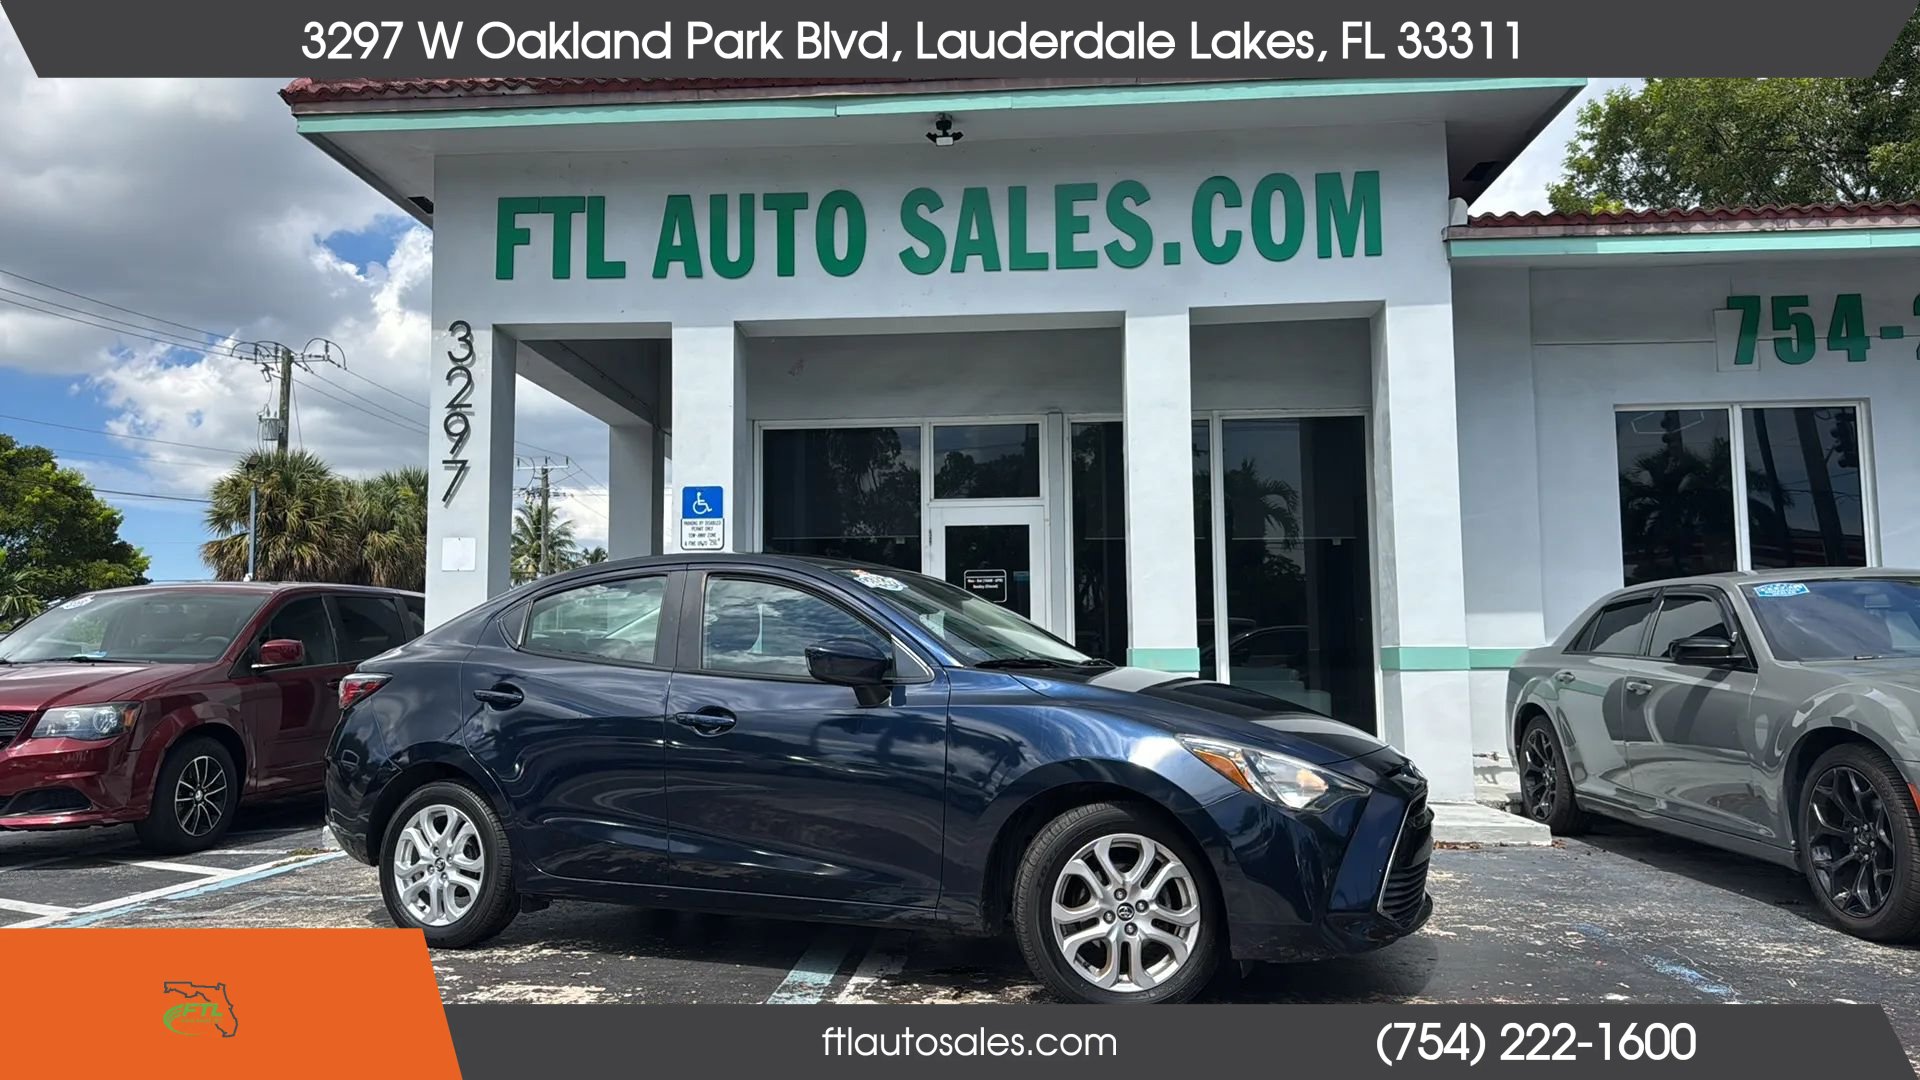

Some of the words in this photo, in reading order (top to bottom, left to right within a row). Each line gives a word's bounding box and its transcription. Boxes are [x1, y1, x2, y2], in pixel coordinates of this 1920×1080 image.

[495, 195, 626, 280] FTL
[652, 190, 867, 279] AUTO
[899, 170, 1382, 275] SALES.COM
[1726, 293, 1920, 365] 754-
[441, 320, 475, 503] 3297
